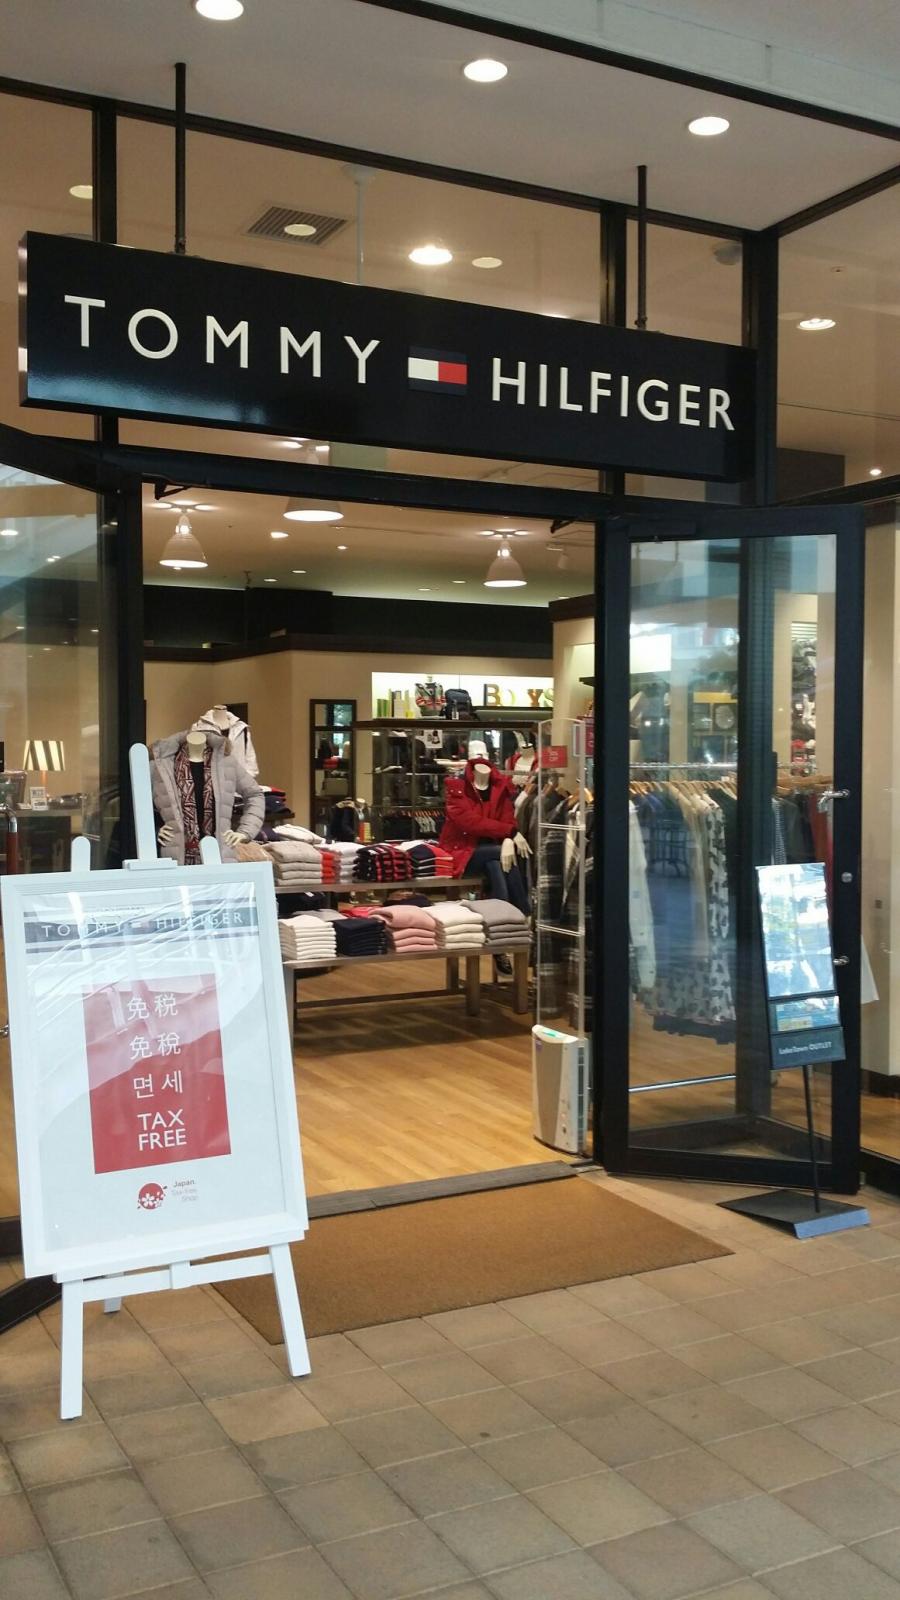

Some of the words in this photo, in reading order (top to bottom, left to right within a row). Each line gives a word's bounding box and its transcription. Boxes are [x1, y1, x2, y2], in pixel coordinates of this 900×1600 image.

[64, 294, 381, 384] TOMMY
[492, 357, 735, 431] HILFIGER
[41, 920, 121, 938] TOMY
[156, 910, 243, 930] HIIGER
[133, 1070, 184, 1099] 면세
[136, 1109, 185, 1131] TAX
[138, 1129, 187, 1151] FREE
